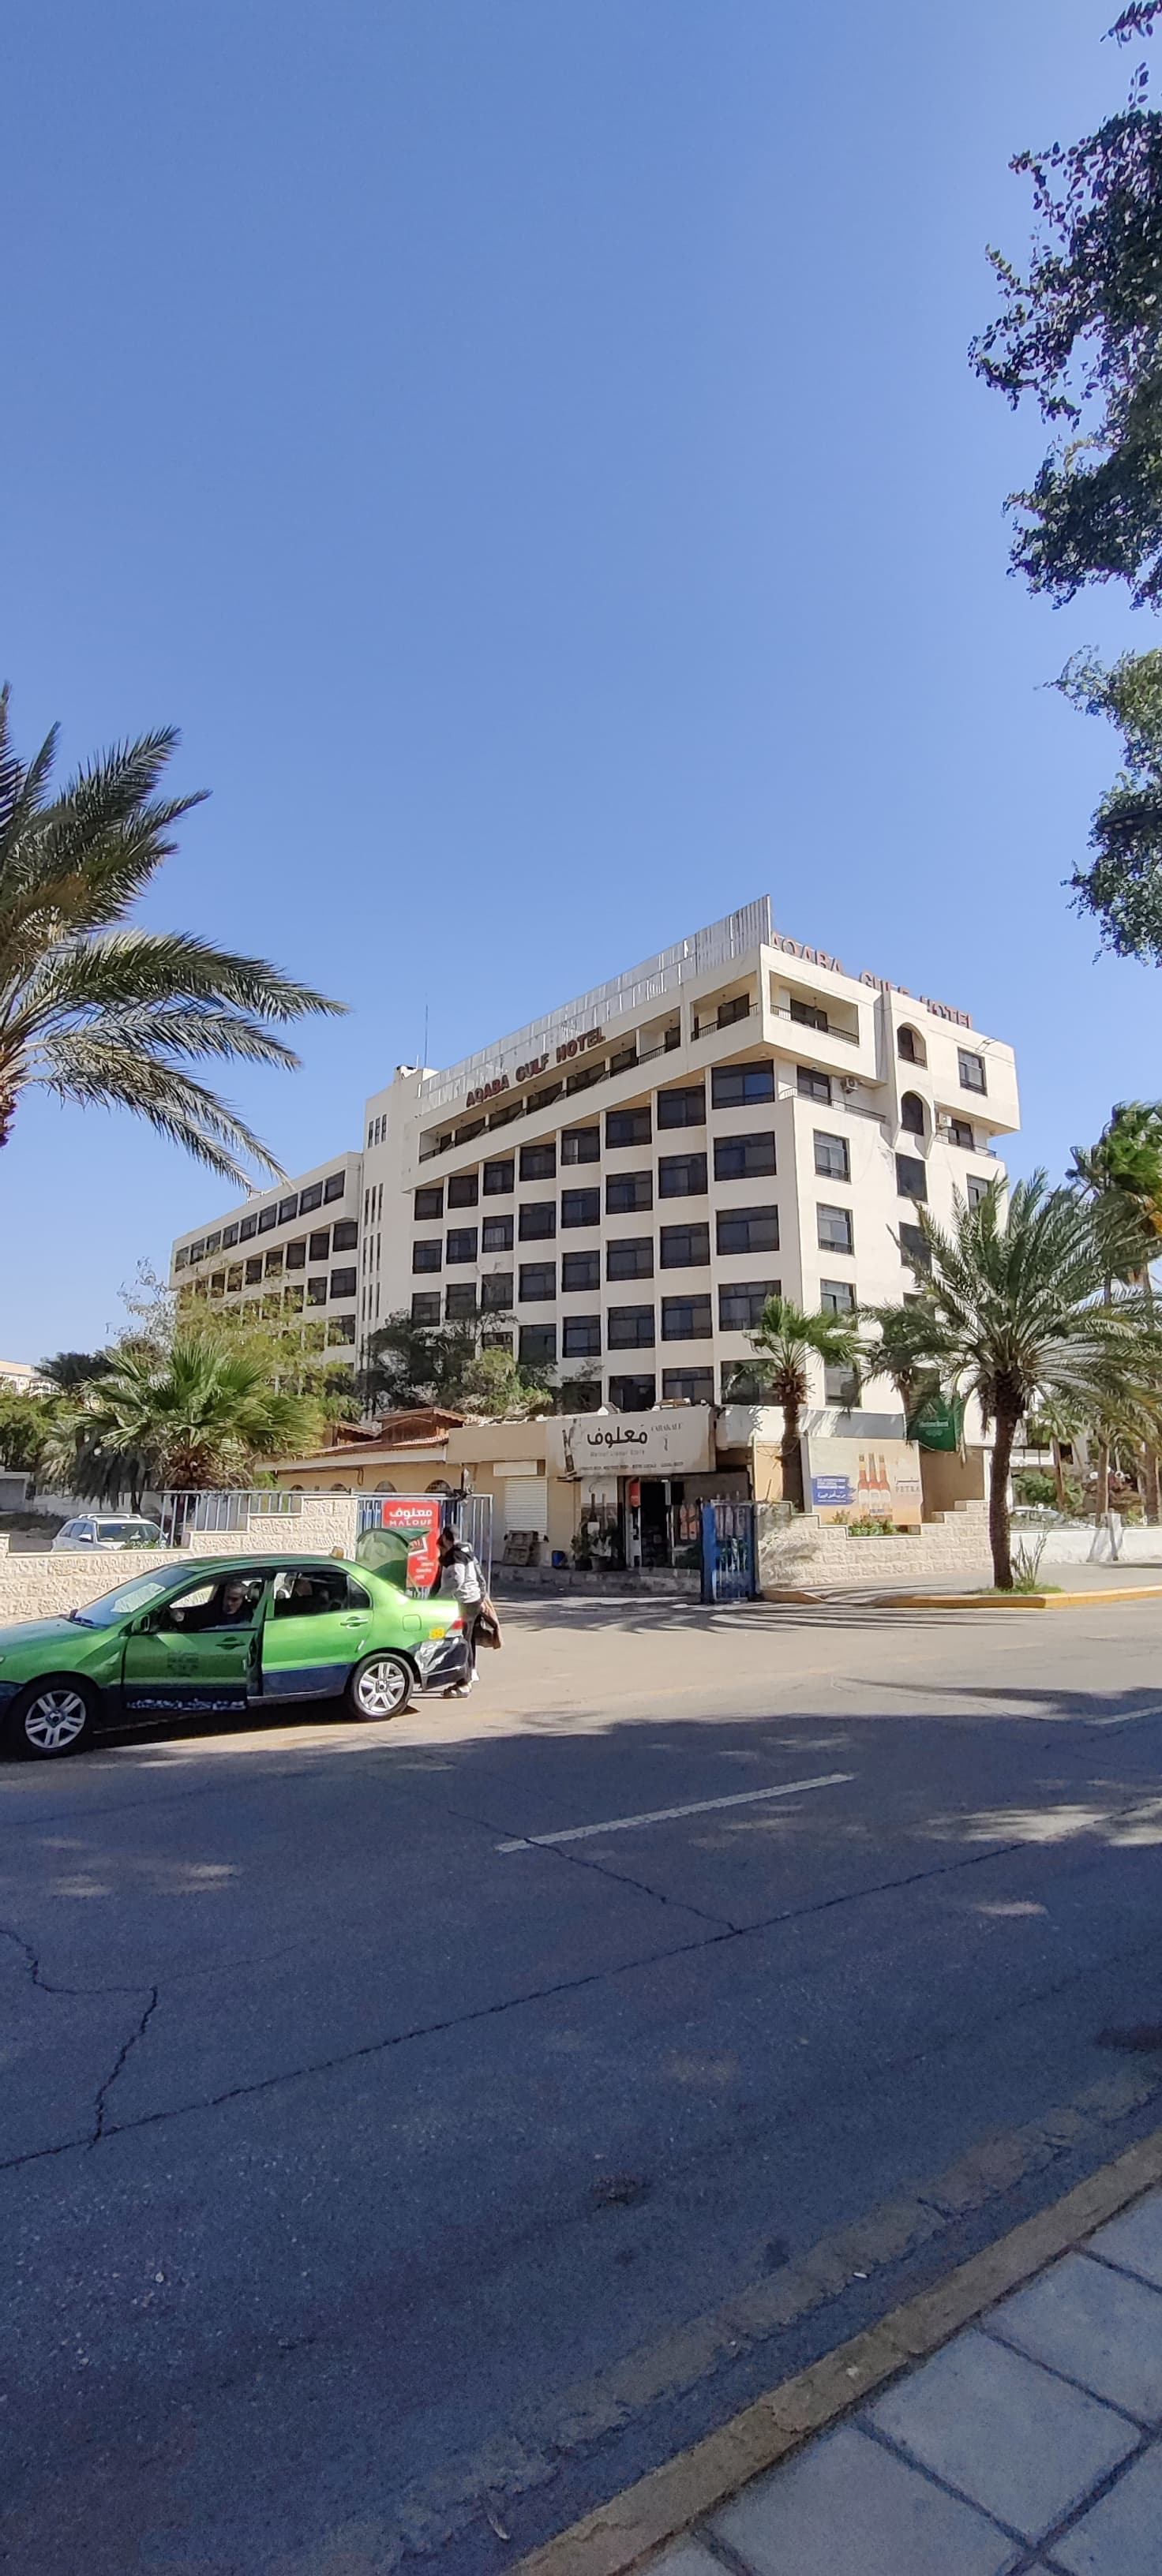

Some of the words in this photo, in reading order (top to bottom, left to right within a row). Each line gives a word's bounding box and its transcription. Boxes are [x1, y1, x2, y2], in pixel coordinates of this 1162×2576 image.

[770, 932, 846, 976] AQABA
[466, 1074, 509, 1107] AQABA
[515, 1053, 549, 1082] GULF
[556, 1027, 605, 1063] HOTEL
[388, 1507, 433, 1519] معلوف
